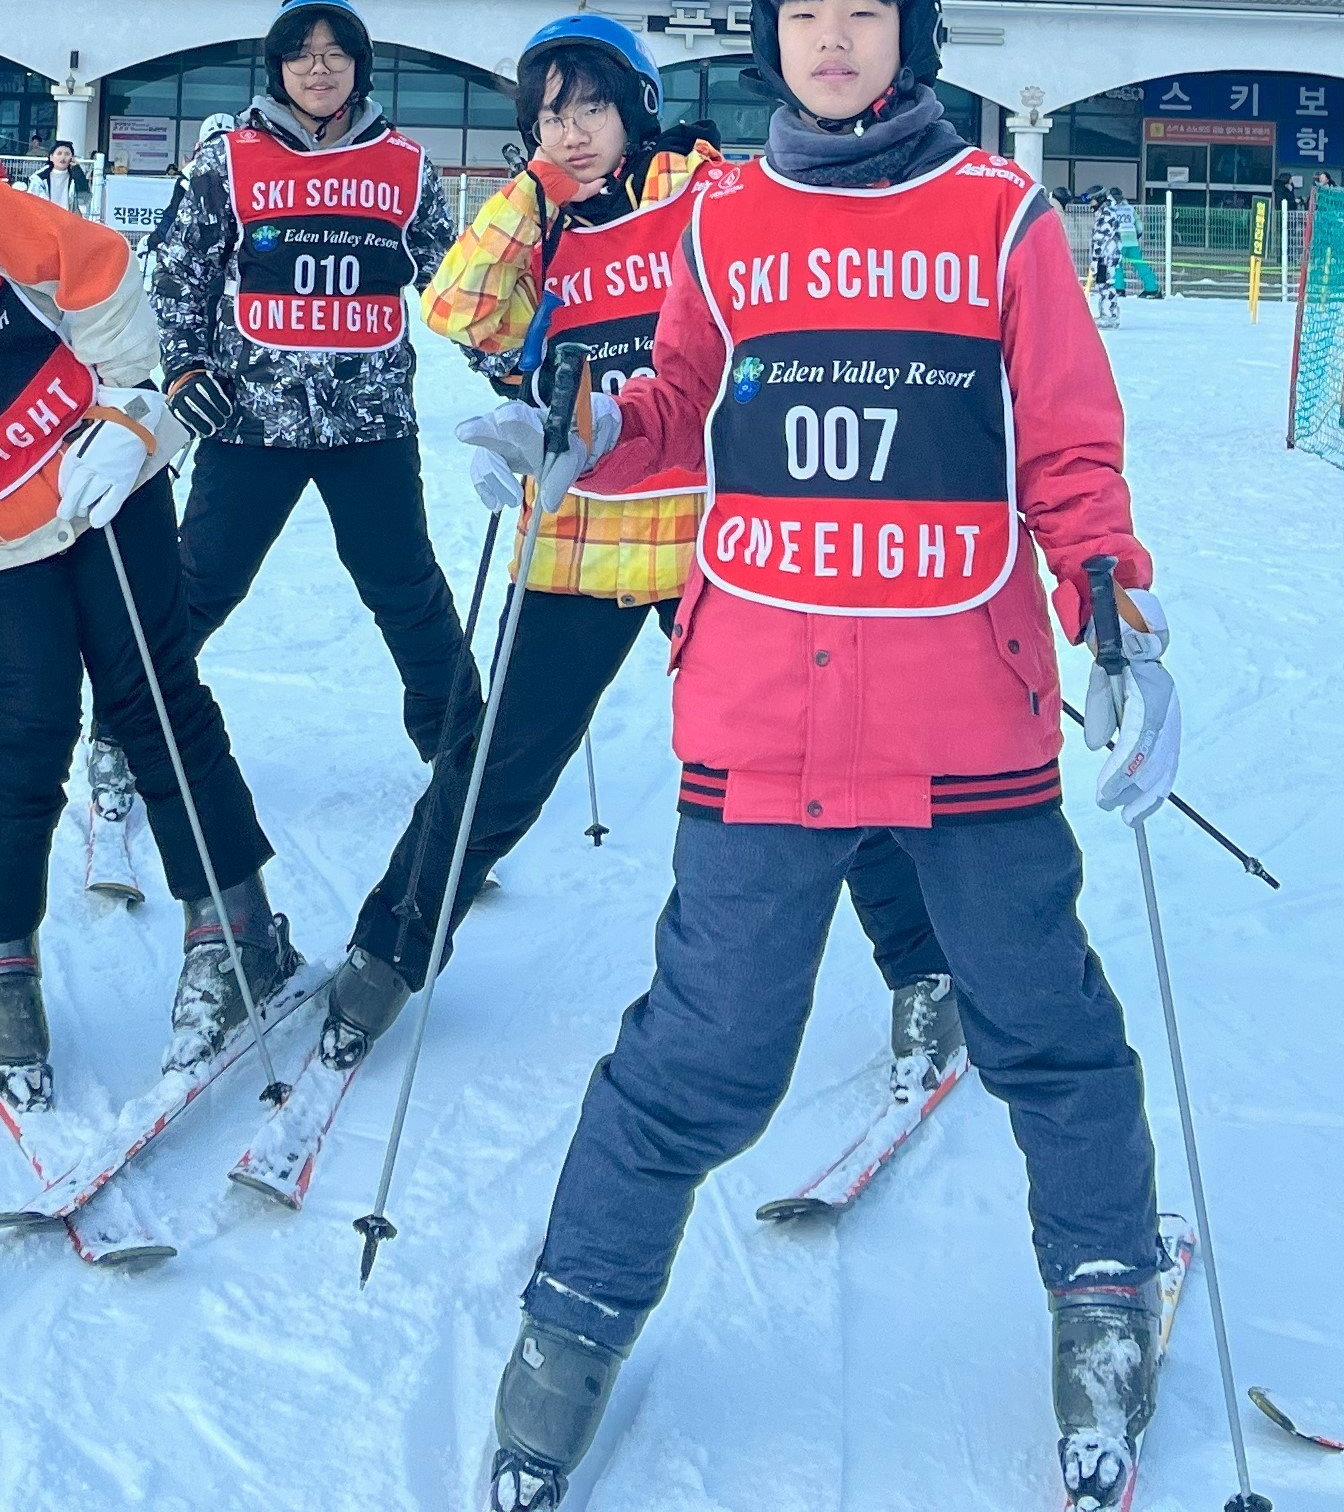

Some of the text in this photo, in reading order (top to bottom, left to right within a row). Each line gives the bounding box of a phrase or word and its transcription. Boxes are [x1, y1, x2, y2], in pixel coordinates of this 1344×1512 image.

[955, 161, 1026, 189] Ashram
[252, 178, 404, 216] SKI SCHOOL
[284, 228, 320, 243] Eden
[323, 230, 362, 248] Valley
[293, 254, 361, 296] 010
[727, 247, 990, 311] SKI SCHOOL
[248, 299, 394, 334] ONEEIGHT
[586, 341, 629, 362] Eden
[766, 359, 977, 390] Eden Valley Resort
[784, 405, 899, 482] 007
[716, 515, 981, 579] ONEEIGHT
